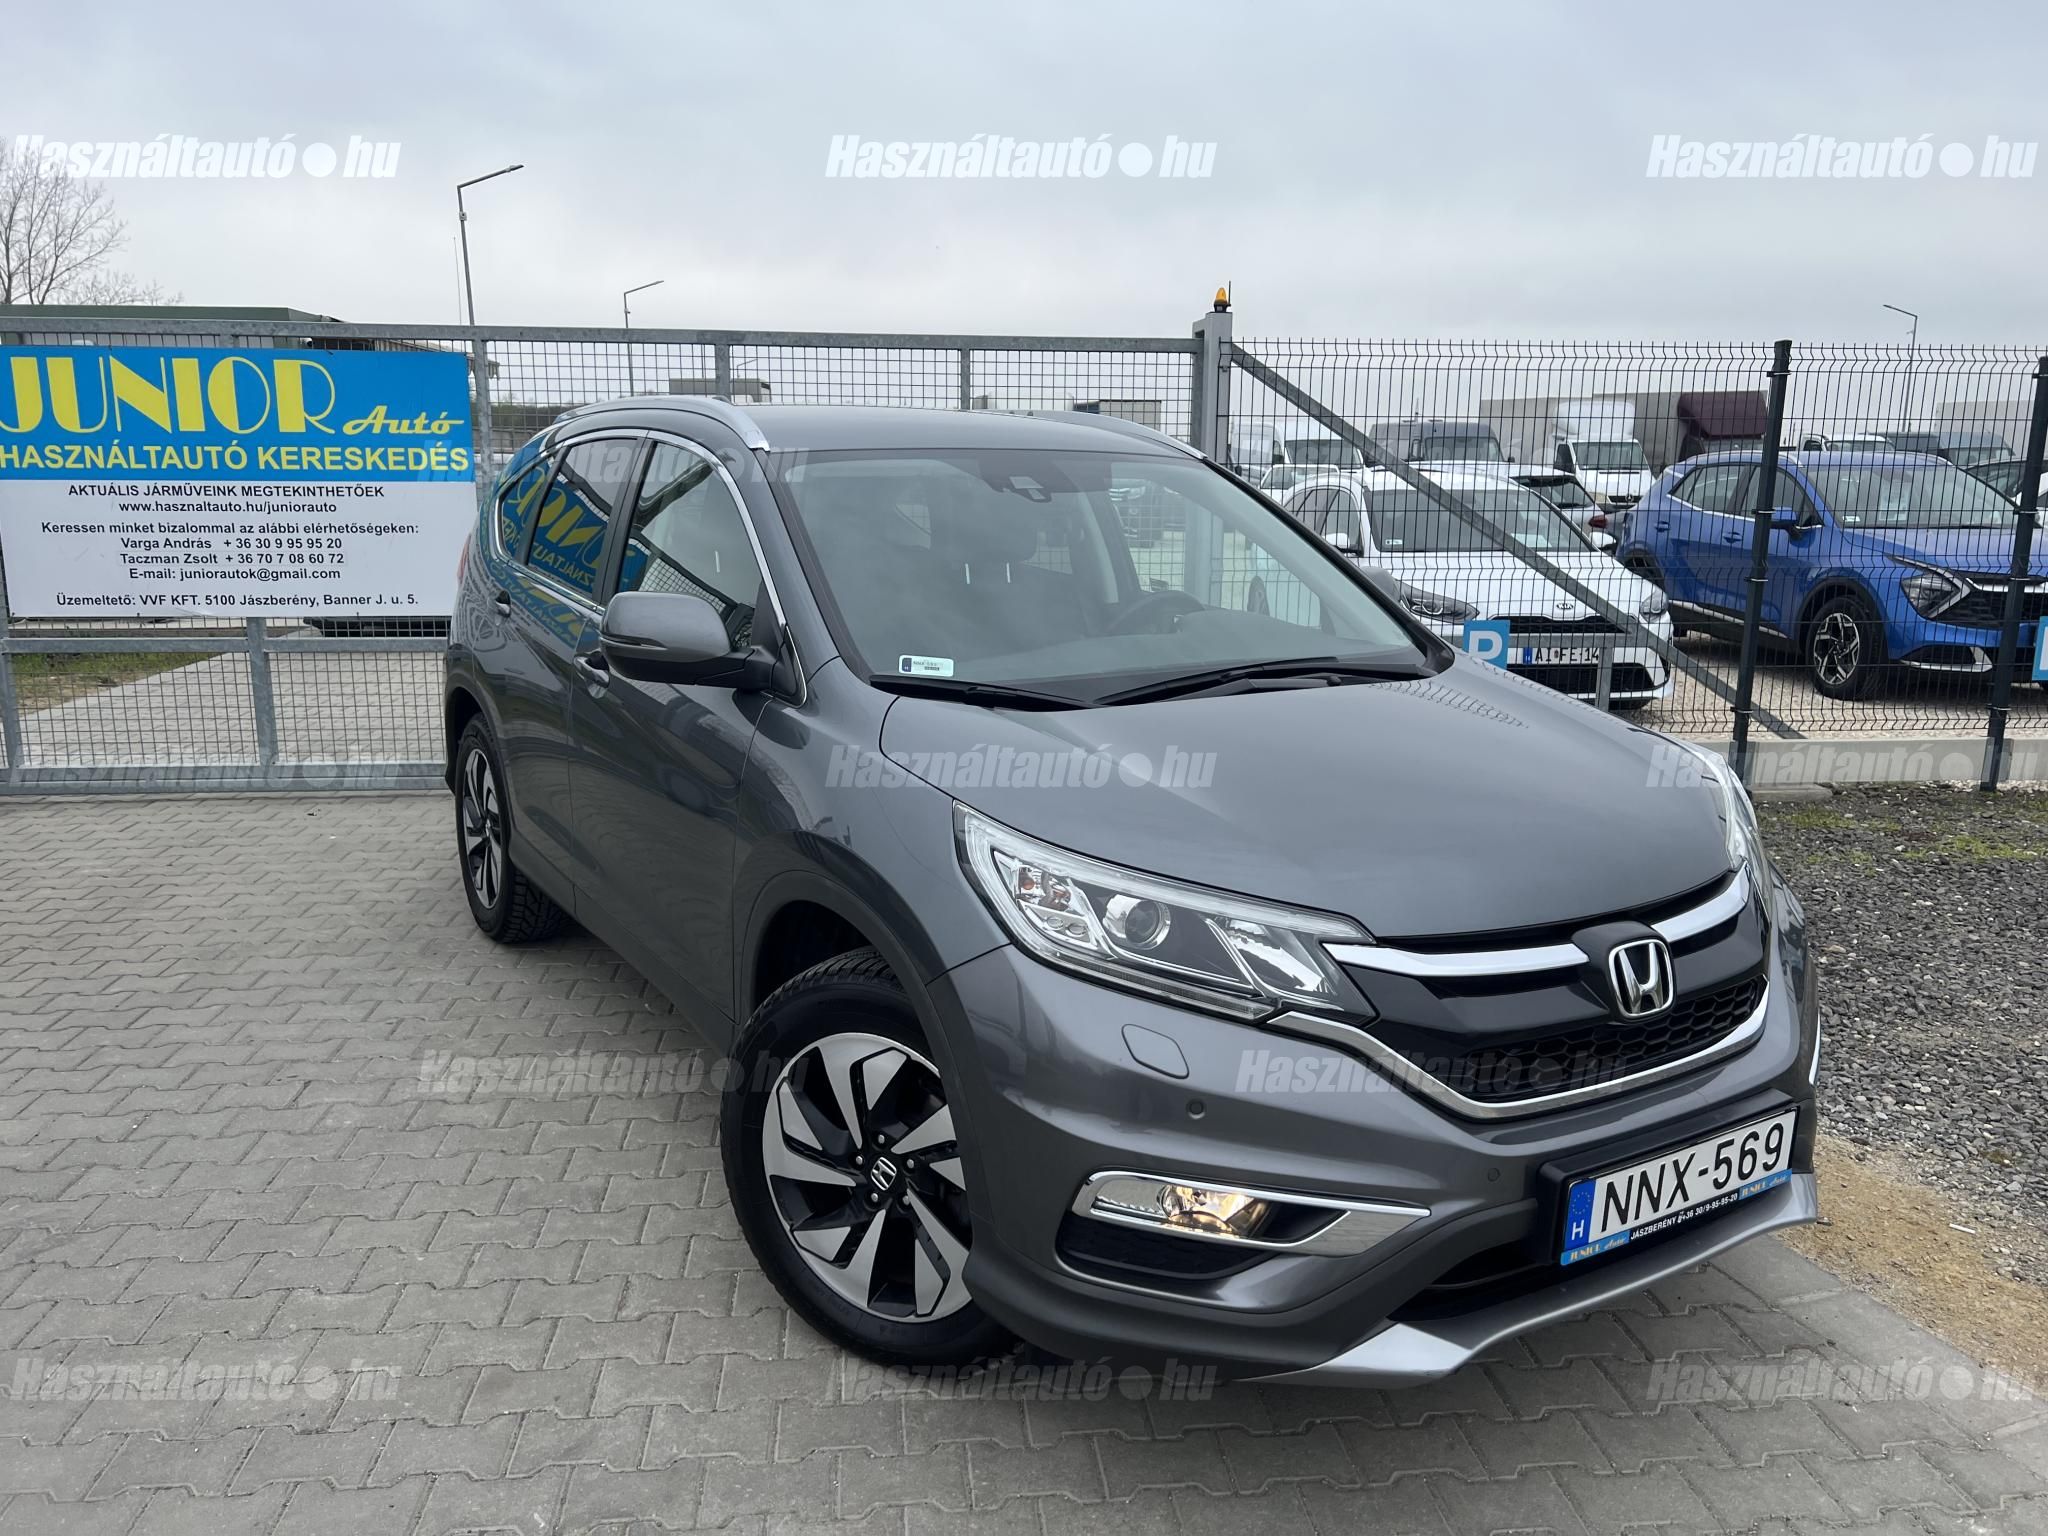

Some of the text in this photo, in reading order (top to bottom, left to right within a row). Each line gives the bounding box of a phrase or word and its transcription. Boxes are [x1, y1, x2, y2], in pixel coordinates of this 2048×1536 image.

[0, 355, 465, 435] JUNIOR Autó
[0, 439, 469, 471] HASZNÁLTAUTÓ KERESKEDÉS
[68, 482, 139, 496] AKTUÁLIS
[241, 483, 385, 497] MEGTEKINTHETŐEK
[119, 501, 337, 514] www.hasznaltauto.hu/juniorauto
[41, 521, 419, 536] Keressen minket bizalommal az alábbi elérhetőségeken:
[121, 538, 160, 550] Varga
[163, 538, 212, 549] András
[235, 538, 251, 549] 36
[255, 538, 271, 549] 30
[275, 538, 283, 549] 9
[286, 538, 302, 549] 95
[306, 538, 322, 549] 95
[326, 538, 342, 549] 20
[120, 553, 179, 565] Taczman
[183, 553, 218, 565] Zsolt
[238, 553, 253, 564] 36
[256, 553, 273, 564] 70
[276, 553, 284, 564] 7
[289, 553, 304, 564] 08
[308, 553, 324, 564] 60
[329, 553, 344, 564] 72
[129, 568, 341, 581] E-mail: juniorautok@gmail.com
[56, 592, 419, 608] Üzemeltető: VVF KFT. 5100 Jászberény, Banner J. u. 5.
[1469, 630, 1503, 660] P
[1559, 648, 1599, 662] FE-14
[1601, 1122, 1785, 1233] NNX-569
[1571, 1220, 1585, 1241] H
